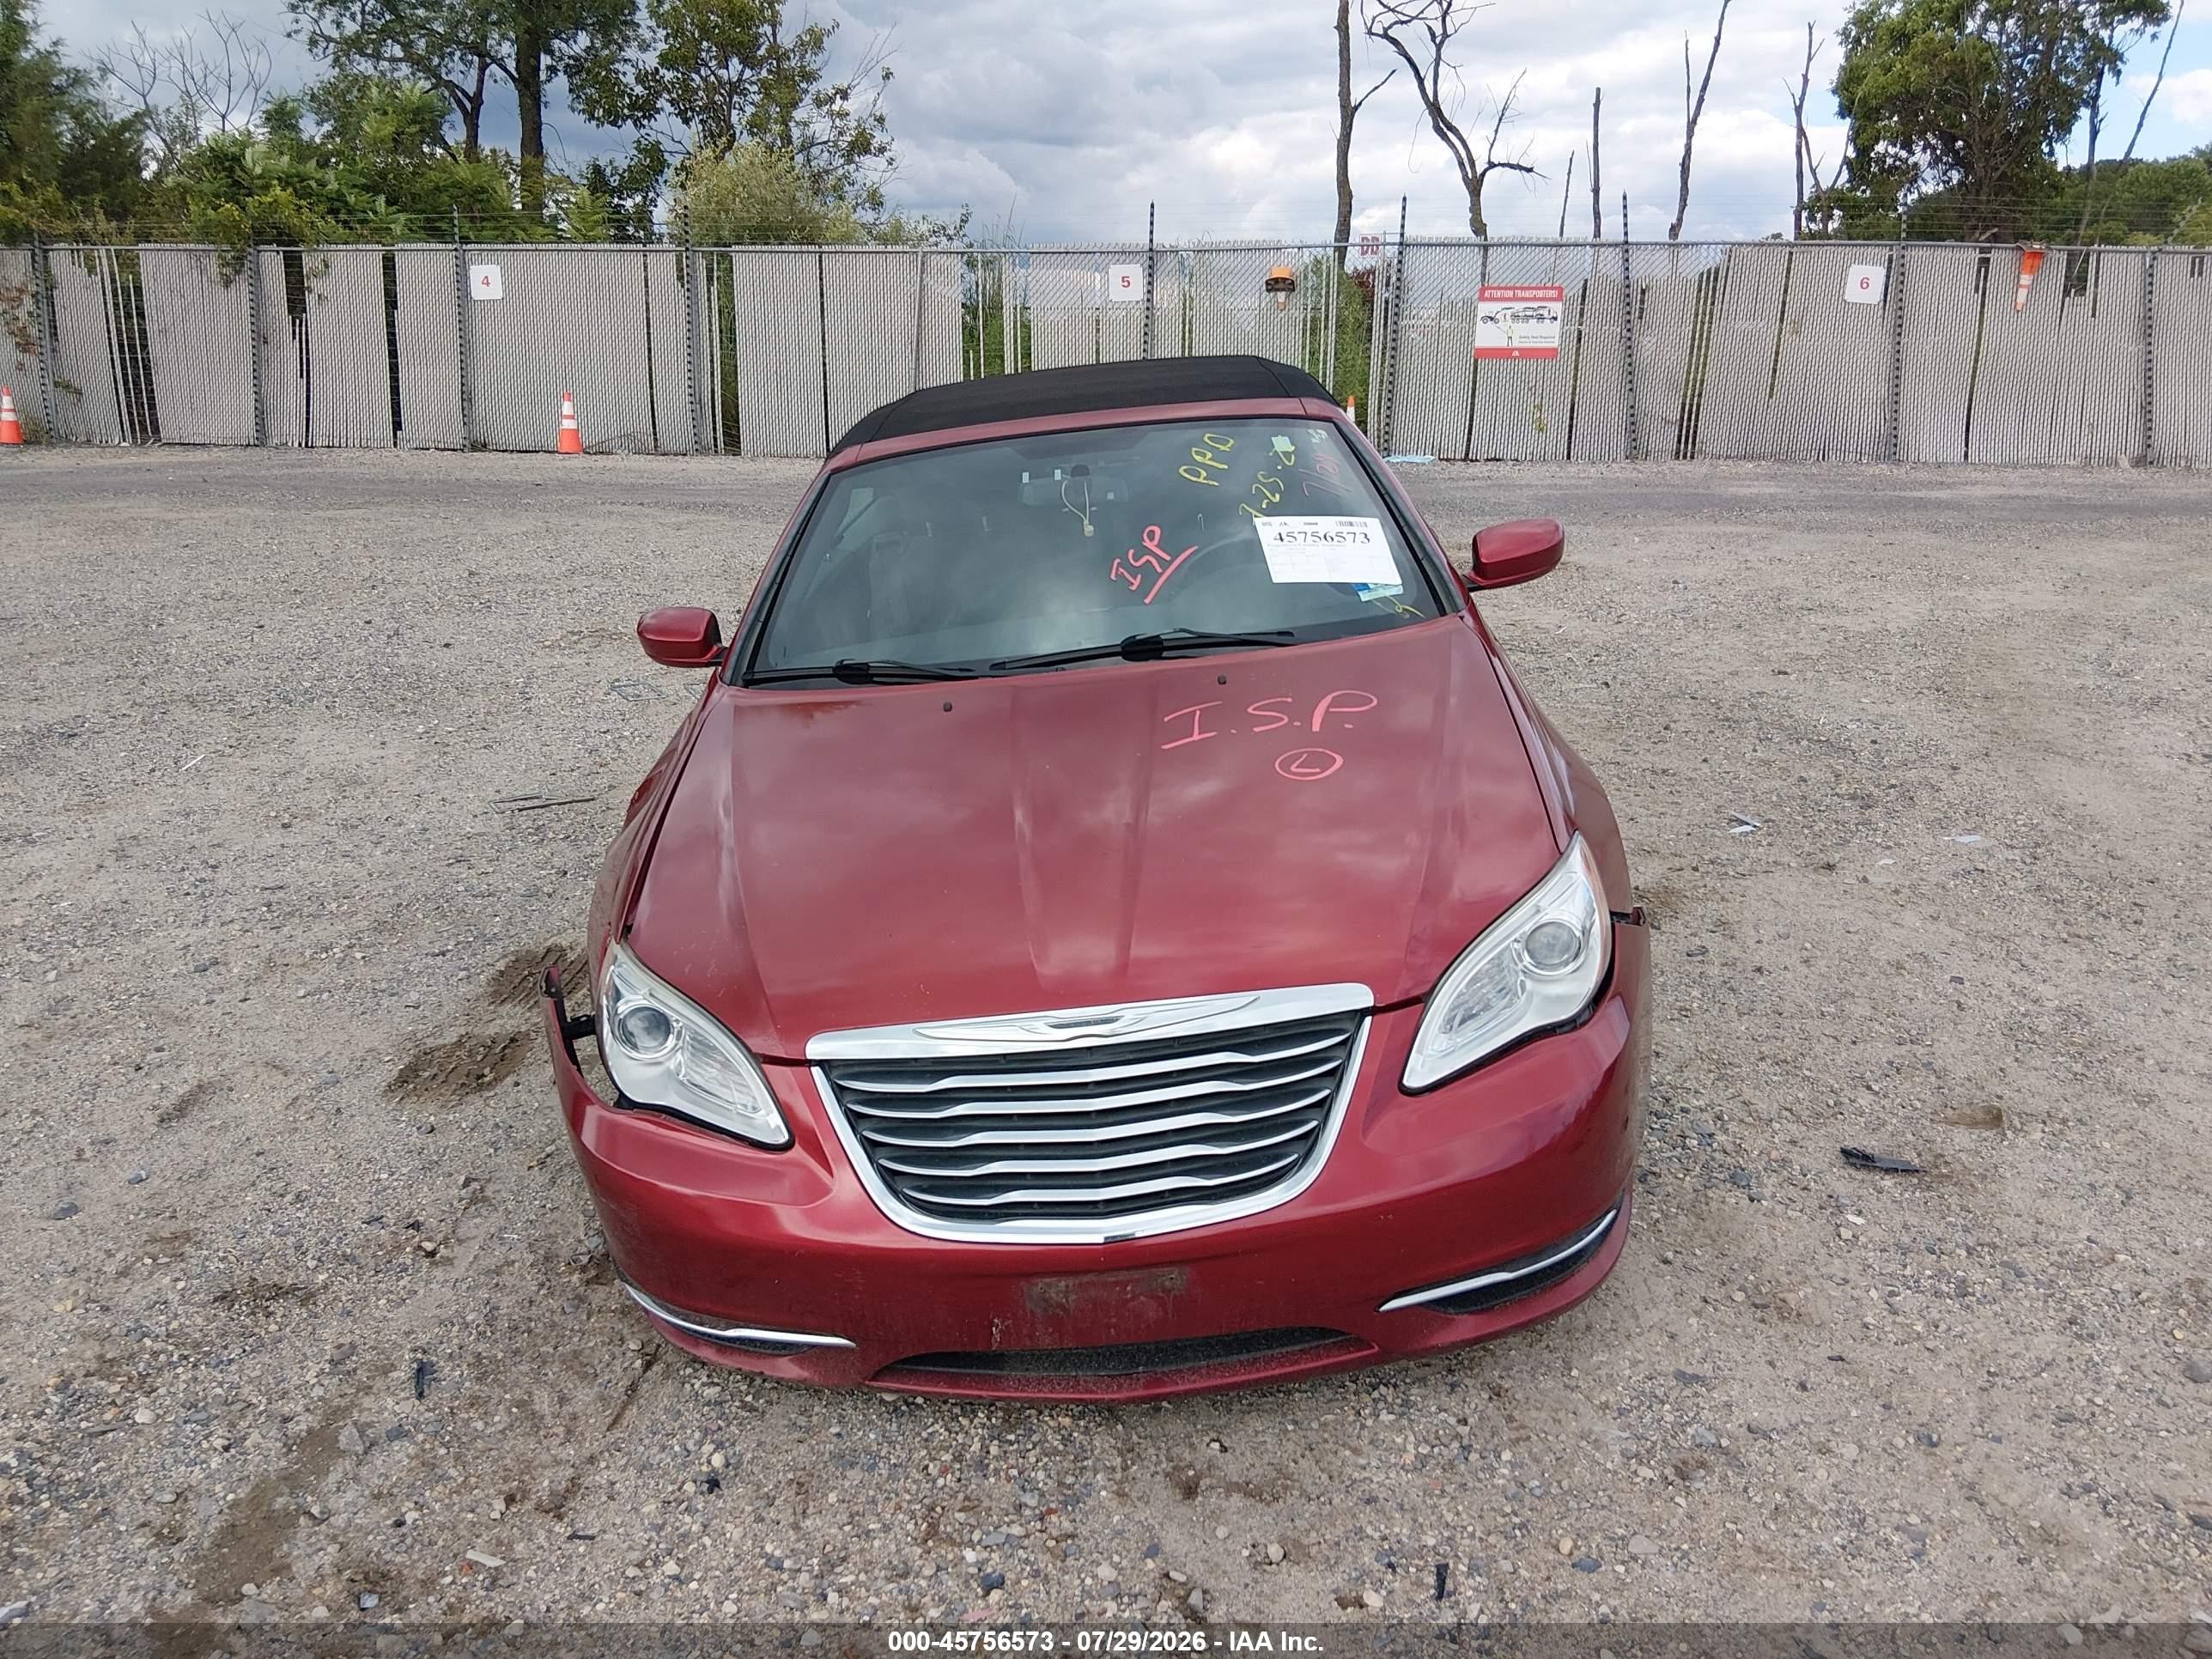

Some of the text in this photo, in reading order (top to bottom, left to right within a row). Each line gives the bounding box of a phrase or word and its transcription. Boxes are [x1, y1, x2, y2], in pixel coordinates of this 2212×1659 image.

[481, 275, 491, 288] 4
[1121, 276, 1131, 289] 5
[1859, 276, 1870, 290] 6
[1484, 289, 1559, 298] ATTENTION TRANSPORTERS!
[1273, 531, 1371, 544] 45756573
[1109, 525, 1171, 592] ISP
